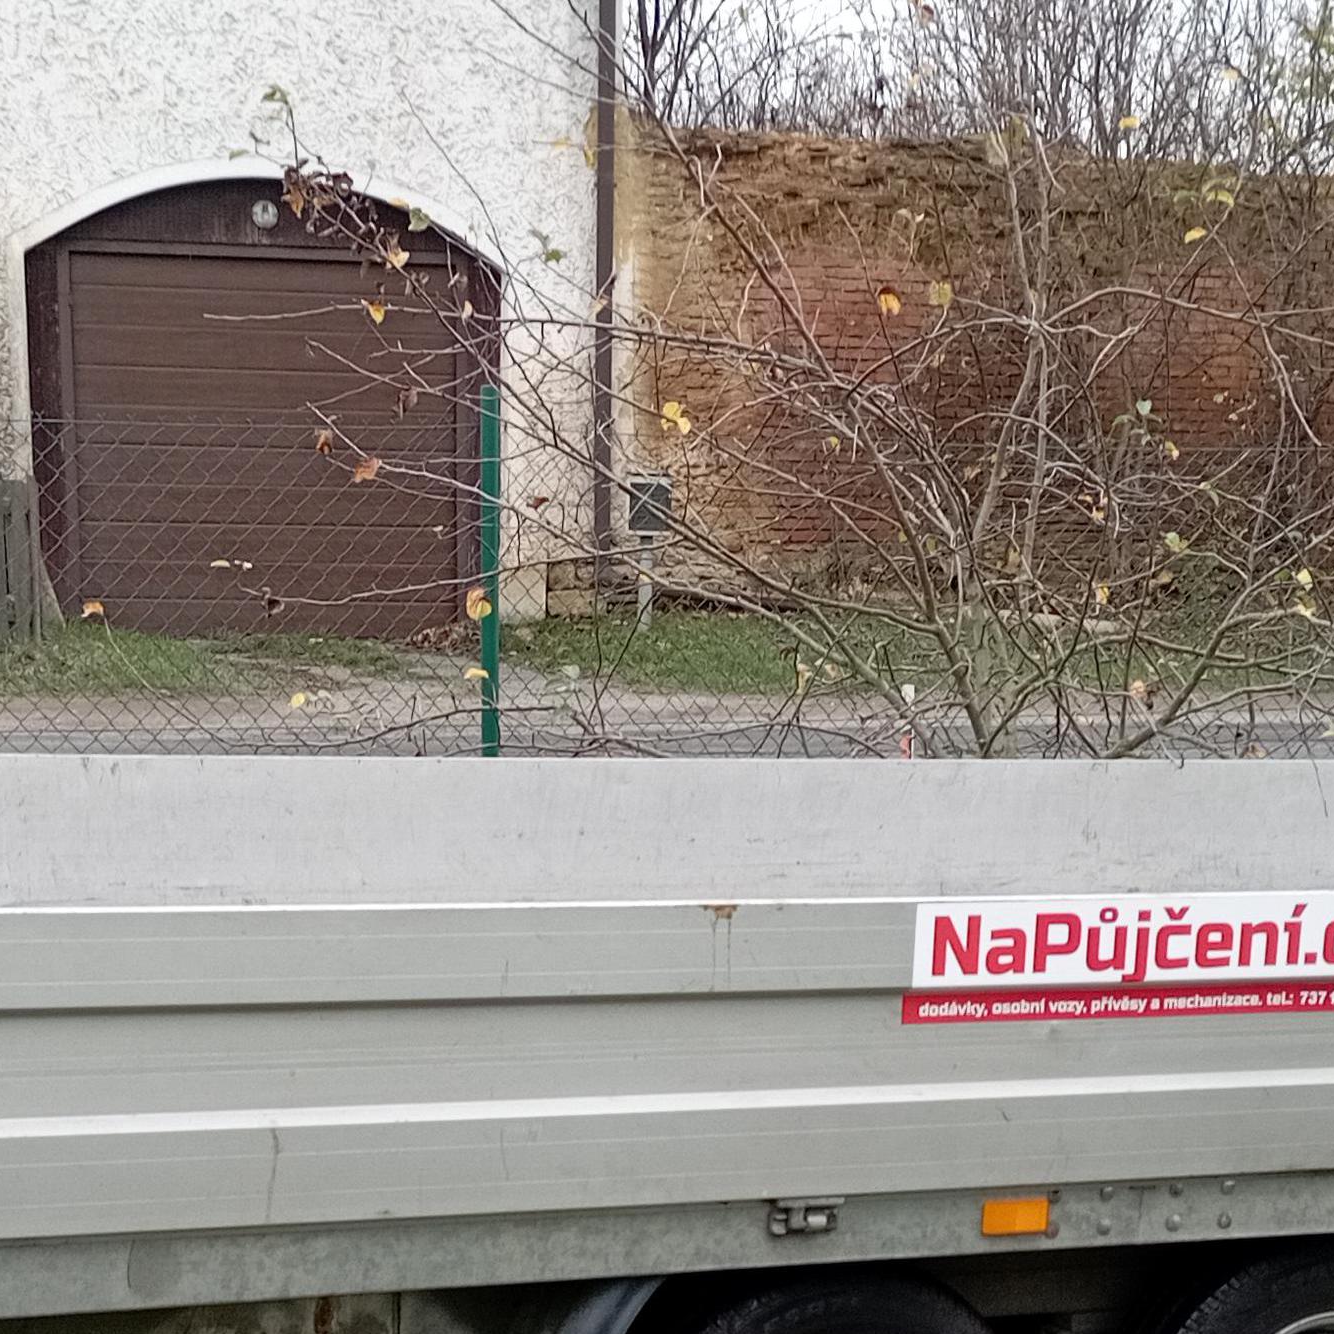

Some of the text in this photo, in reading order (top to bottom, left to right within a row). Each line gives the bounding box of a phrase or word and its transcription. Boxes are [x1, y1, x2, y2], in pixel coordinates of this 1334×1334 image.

[919, 1001, 988, 1018] dodávky,
[992, 999, 1045, 1015] osobní
[1049, 1000, 1087, 1015] vozy,
[1091, 997, 1147, 1014] přívěsy
[1150, 998, 1160, 1010] a
[1299, 990, 1327, 1005] 737
